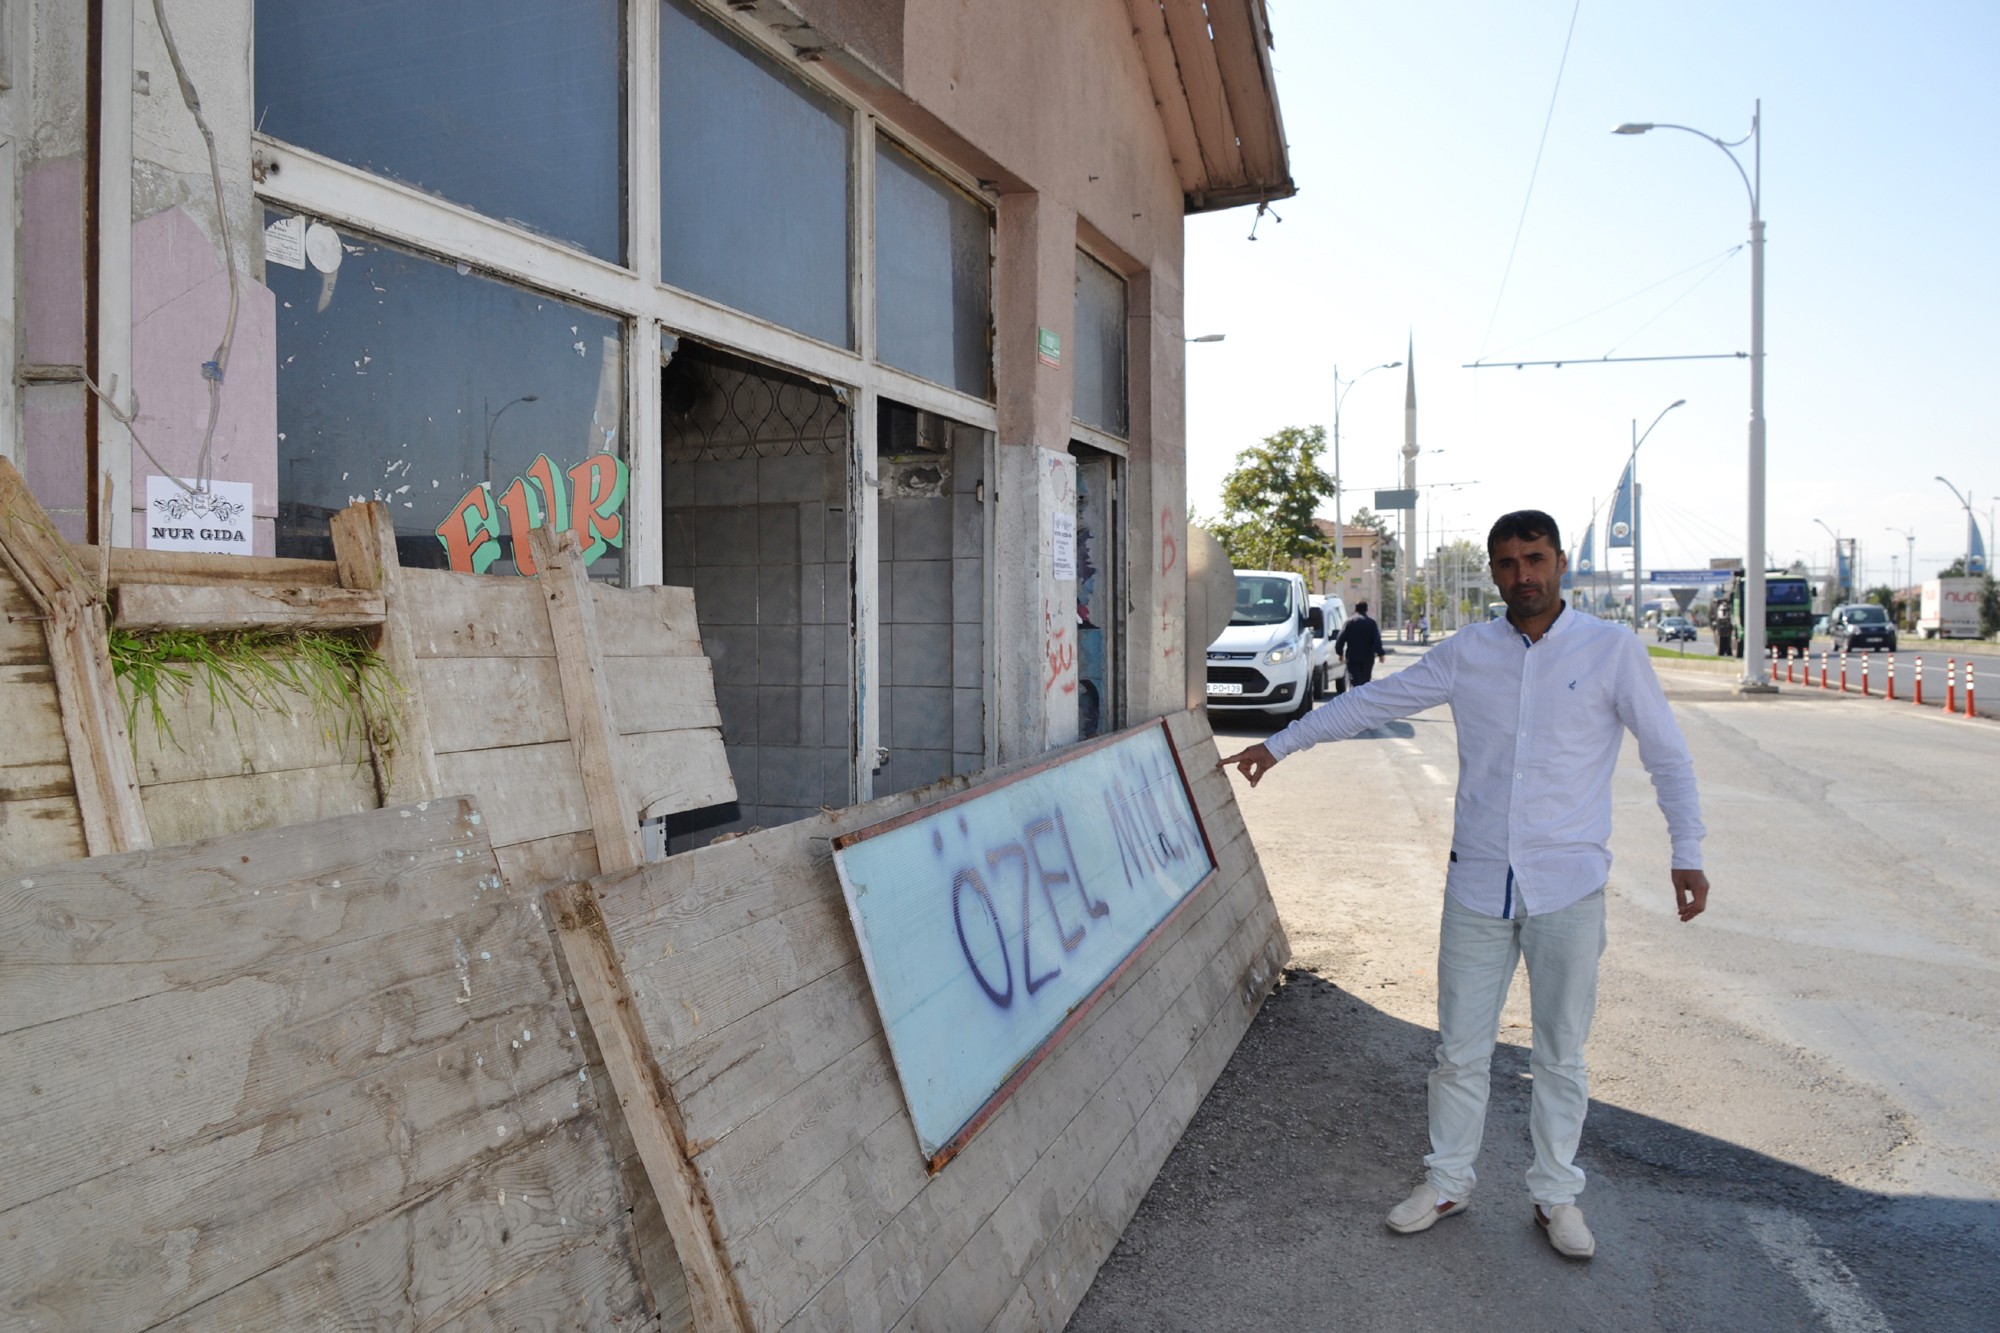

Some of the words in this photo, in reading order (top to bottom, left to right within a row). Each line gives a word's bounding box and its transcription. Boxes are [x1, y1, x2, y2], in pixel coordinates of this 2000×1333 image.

[152, 527, 195, 540] NUR
[200, 528, 246, 542] GIDA
[932, 804, 1110, 1010] ÖZEL
